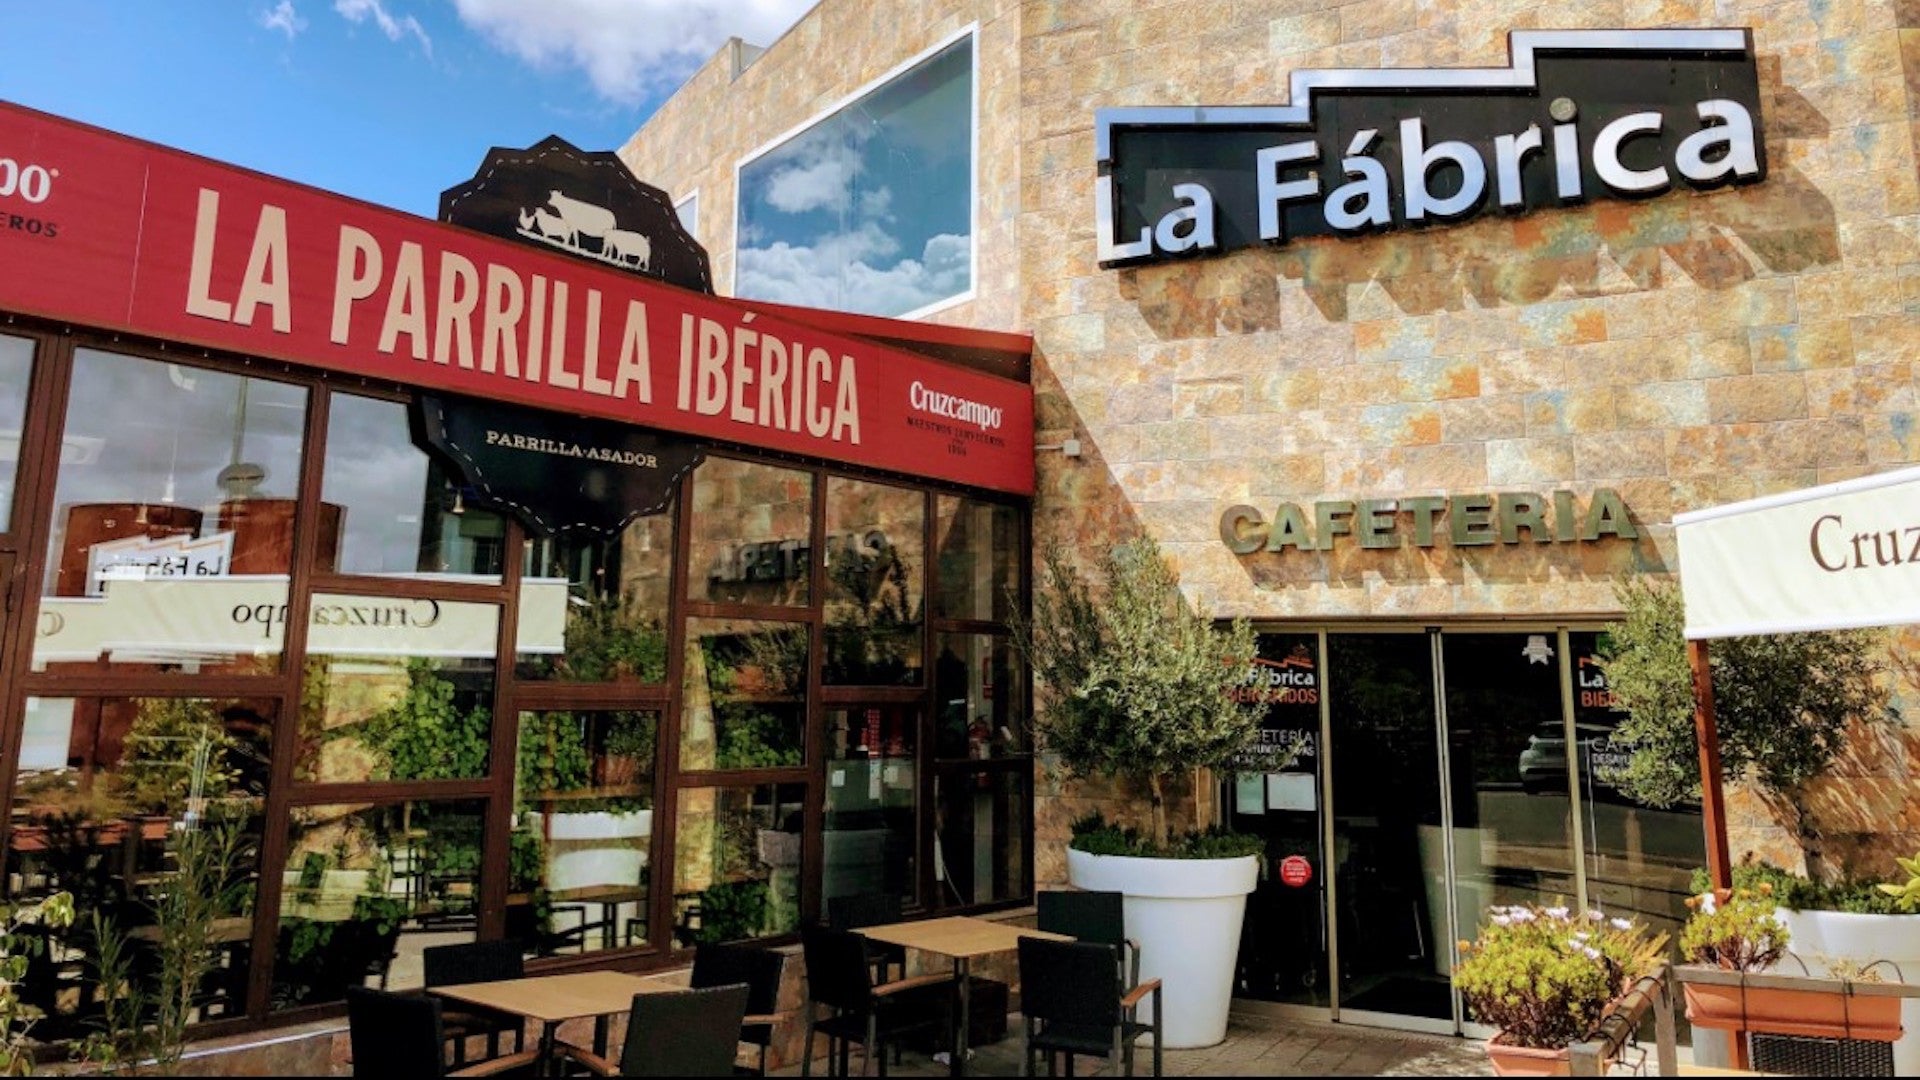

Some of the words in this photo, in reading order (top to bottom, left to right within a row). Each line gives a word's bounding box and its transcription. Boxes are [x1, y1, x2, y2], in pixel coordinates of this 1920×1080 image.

[1097, 176, 1217, 268] La
[1256, 97, 1760, 240] Fábrica
[186, 187, 292, 334] LA
[330, 224, 652, 404] PARRILLA
[677, 311, 861, 445] IBÉRICA
[909, 380, 1000, 431] Cruzcampo
[1219, 489, 1639, 555] CAFETERIA
[1248, 668, 1315, 686] Fbrica
